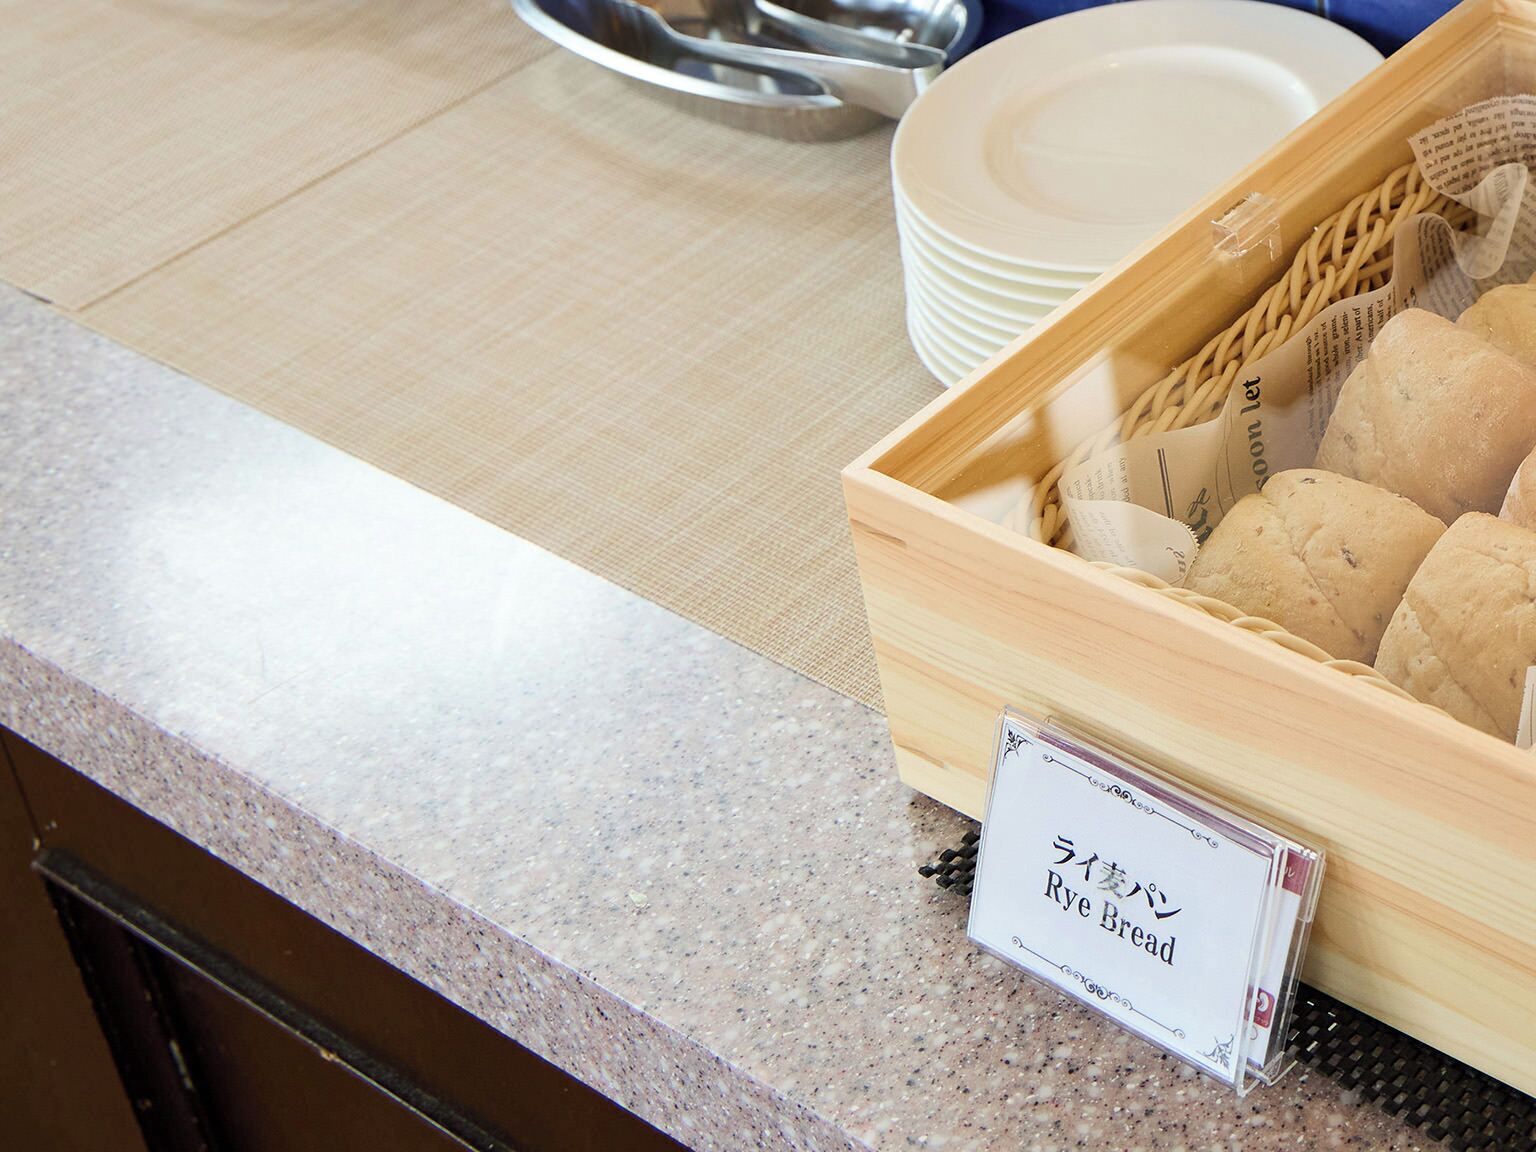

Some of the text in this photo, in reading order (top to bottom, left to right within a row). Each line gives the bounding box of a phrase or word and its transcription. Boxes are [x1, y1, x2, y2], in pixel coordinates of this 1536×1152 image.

[1377, 299, 1384, 307] of
[1330, 315, 1338, 339] grains,
[1354, 315, 1363, 330] part
[1355, 330, 1362, 341] As
[1240, 374, 1270, 491] soon let
[1106, 462, 1116, 482] when
[1118, 456, 1129, 472] any
[1095, 467, 1106, 488] drink
[1052, 834, 1182, 920] ライ麦パン
[1044, 869, 1176, 966] Rye Bread
